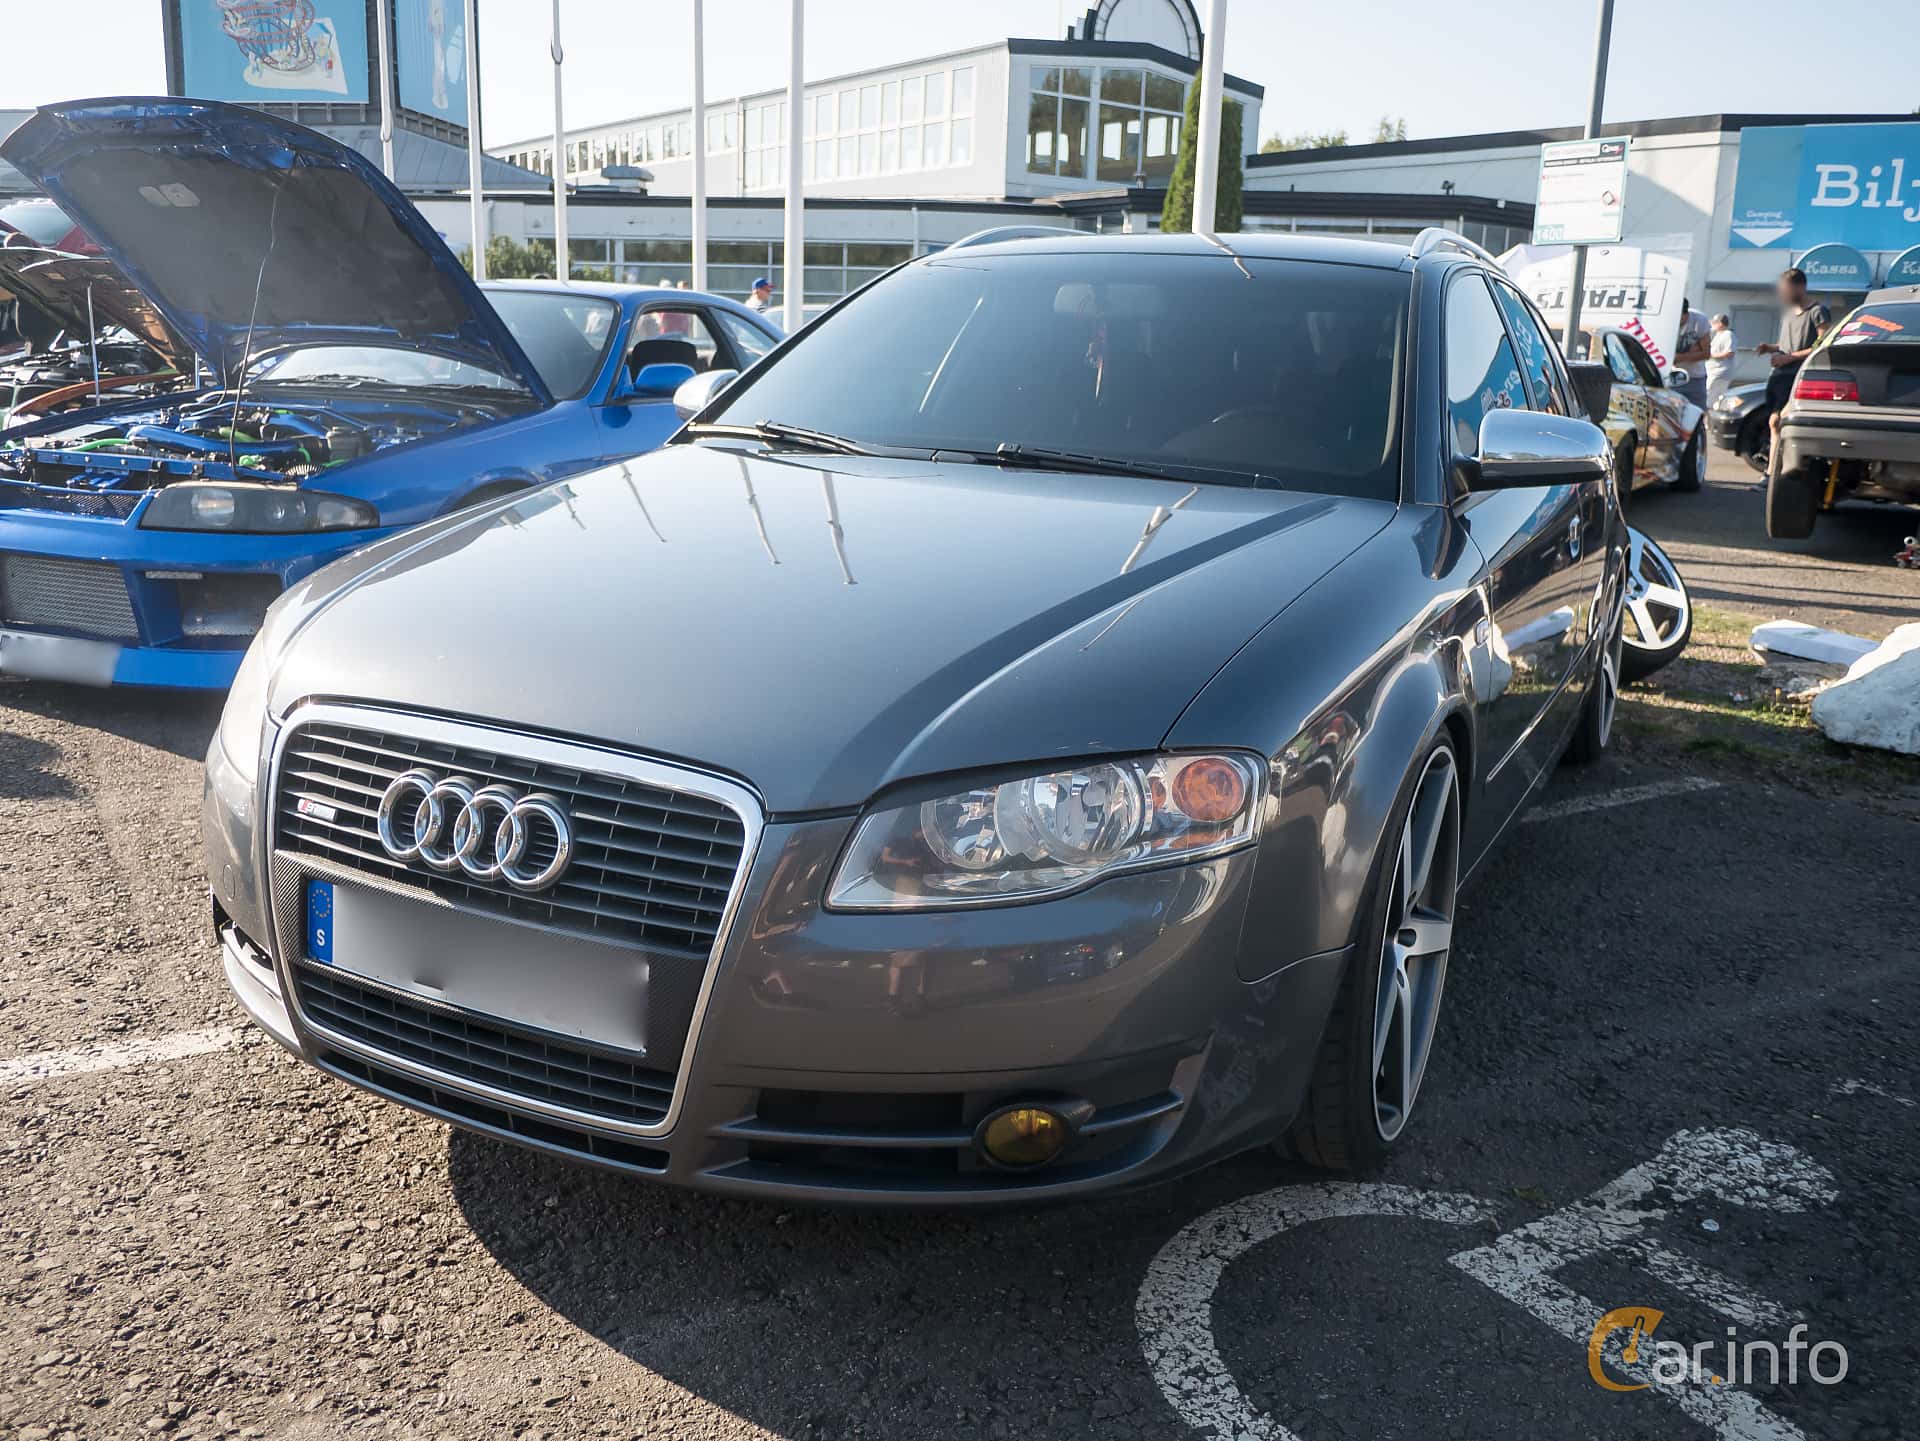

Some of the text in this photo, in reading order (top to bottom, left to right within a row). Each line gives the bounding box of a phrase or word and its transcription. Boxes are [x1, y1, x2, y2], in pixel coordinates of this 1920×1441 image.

[1804, 260, 1858, 275] Kassa
[1536, 288, 1649, 310] T-PATS
[316, 928, 326, 947] S
